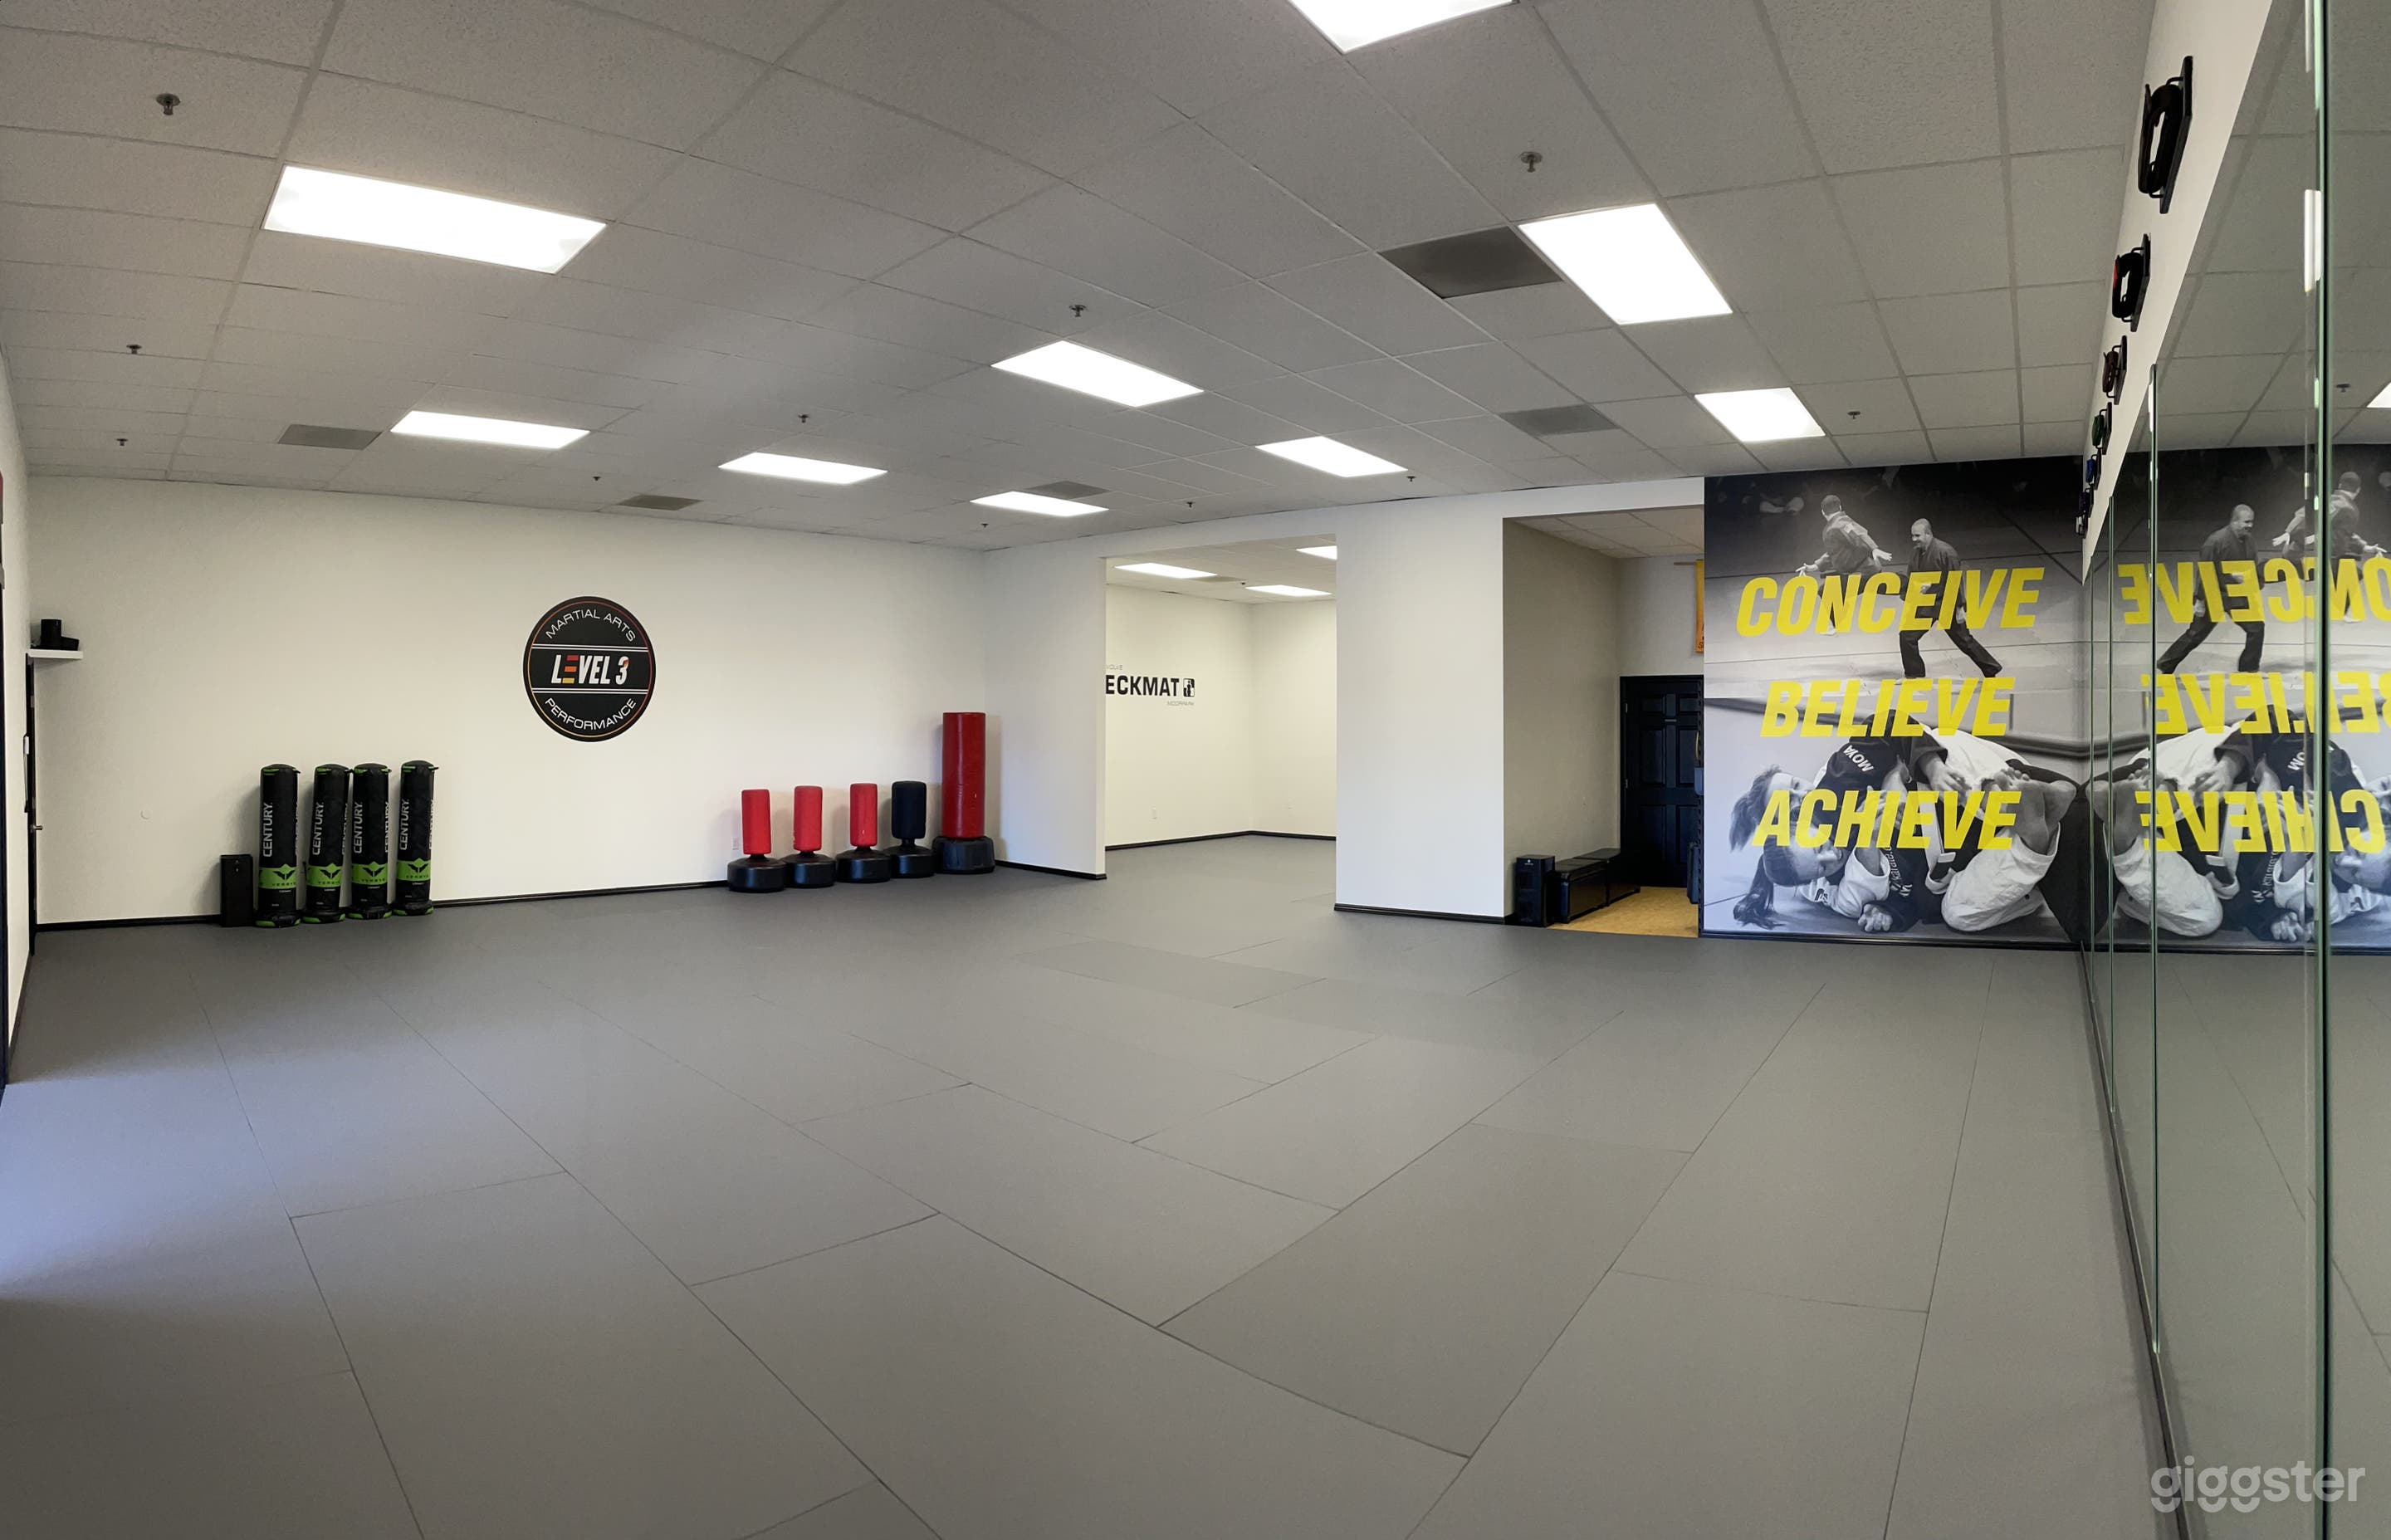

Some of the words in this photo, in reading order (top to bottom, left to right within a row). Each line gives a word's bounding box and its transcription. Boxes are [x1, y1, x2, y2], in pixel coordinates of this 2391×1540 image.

[1735, 567, 2045, 638] CONCEIVE
[545, 609, 600, 639] MARTIAL
[604, 613, 636, 642] ARTS
[551, 654, 610, 685] LEVEL
[615, 656, 629, 685] 3
[545, 697, 637, 731] PERFORMANCE
[1761, 677, 2015, 737] BELIEVE
[1843, 745, 1874, 771] MOYA
[1752, 790, 2022, 850] ACHIEVE
